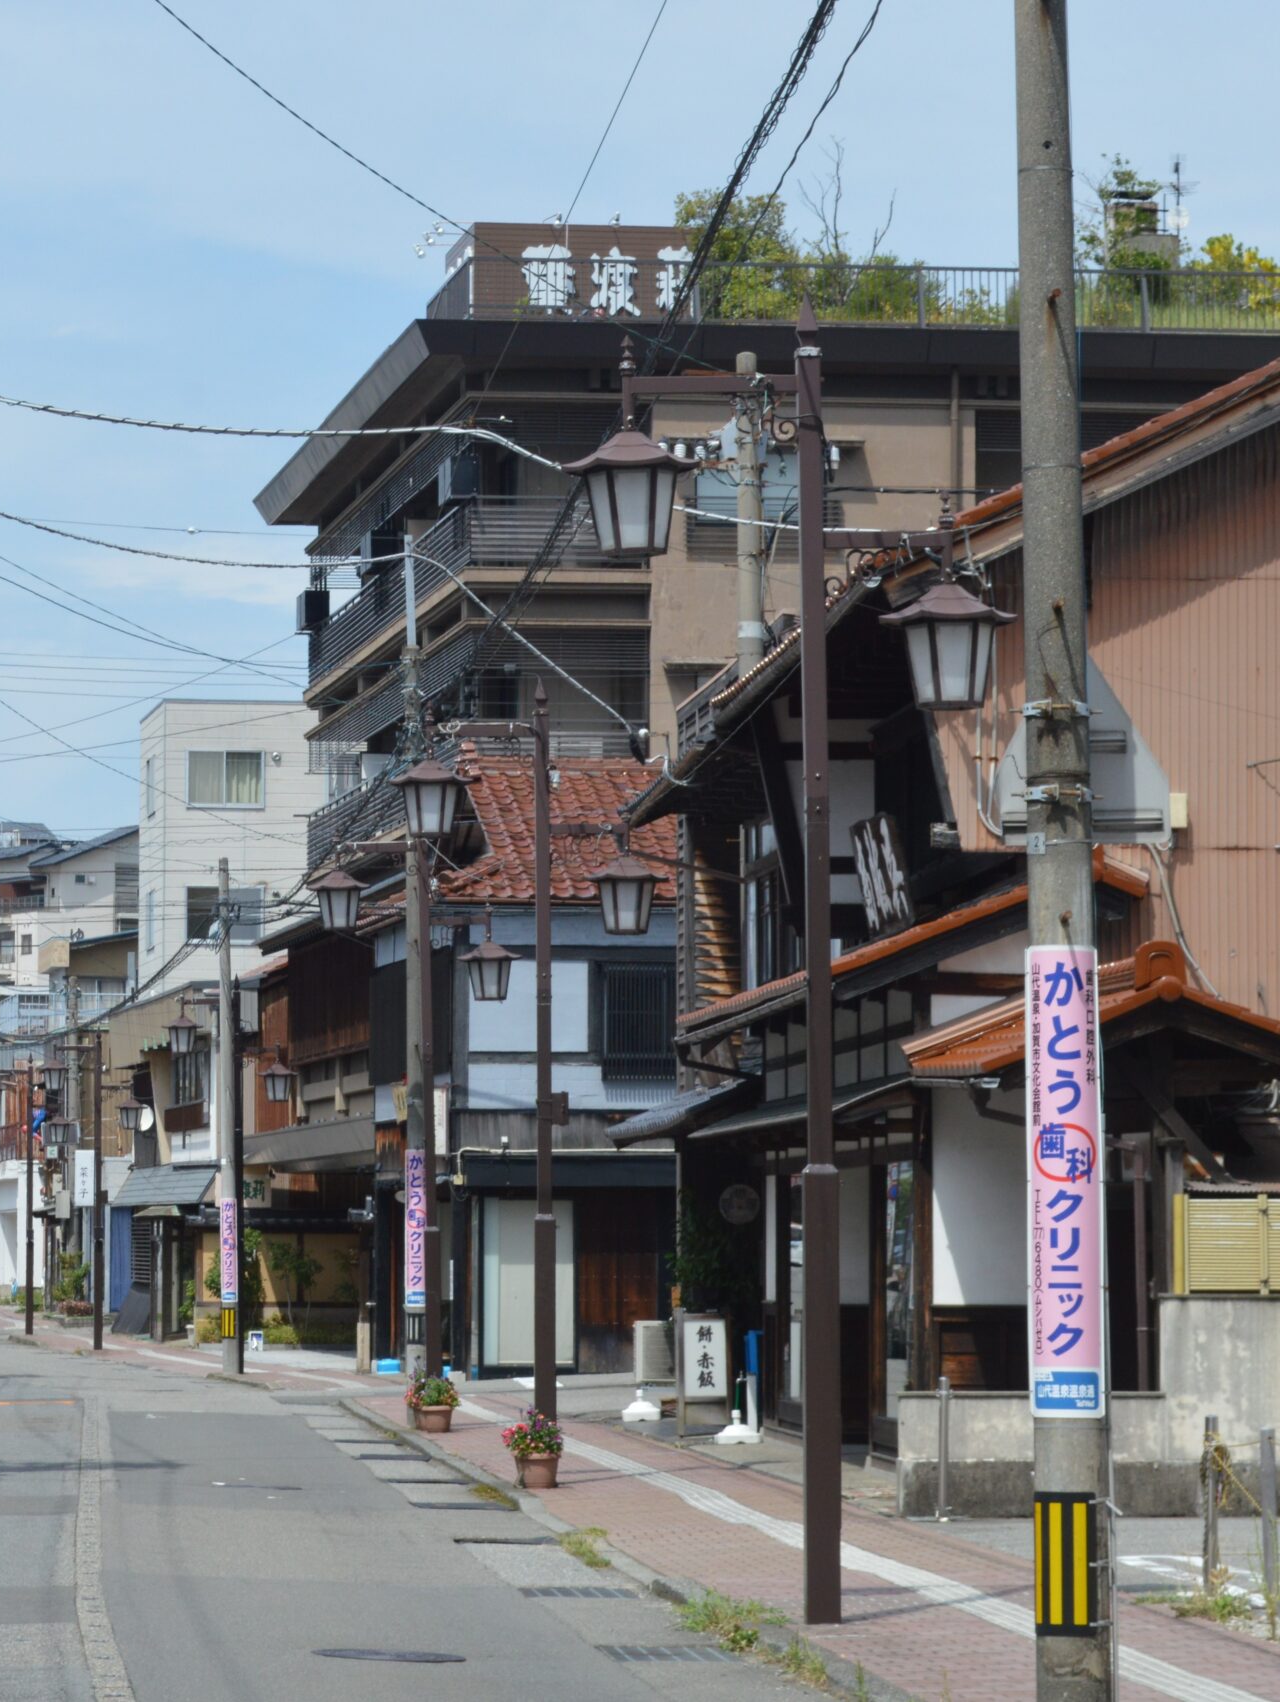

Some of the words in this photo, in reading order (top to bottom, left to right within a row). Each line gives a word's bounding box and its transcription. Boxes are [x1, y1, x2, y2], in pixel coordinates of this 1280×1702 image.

[1084, 969, 1096, 1086] 歯科口腔外科
[1038, 961, 1094, 1358] かとう歯科クリニック
